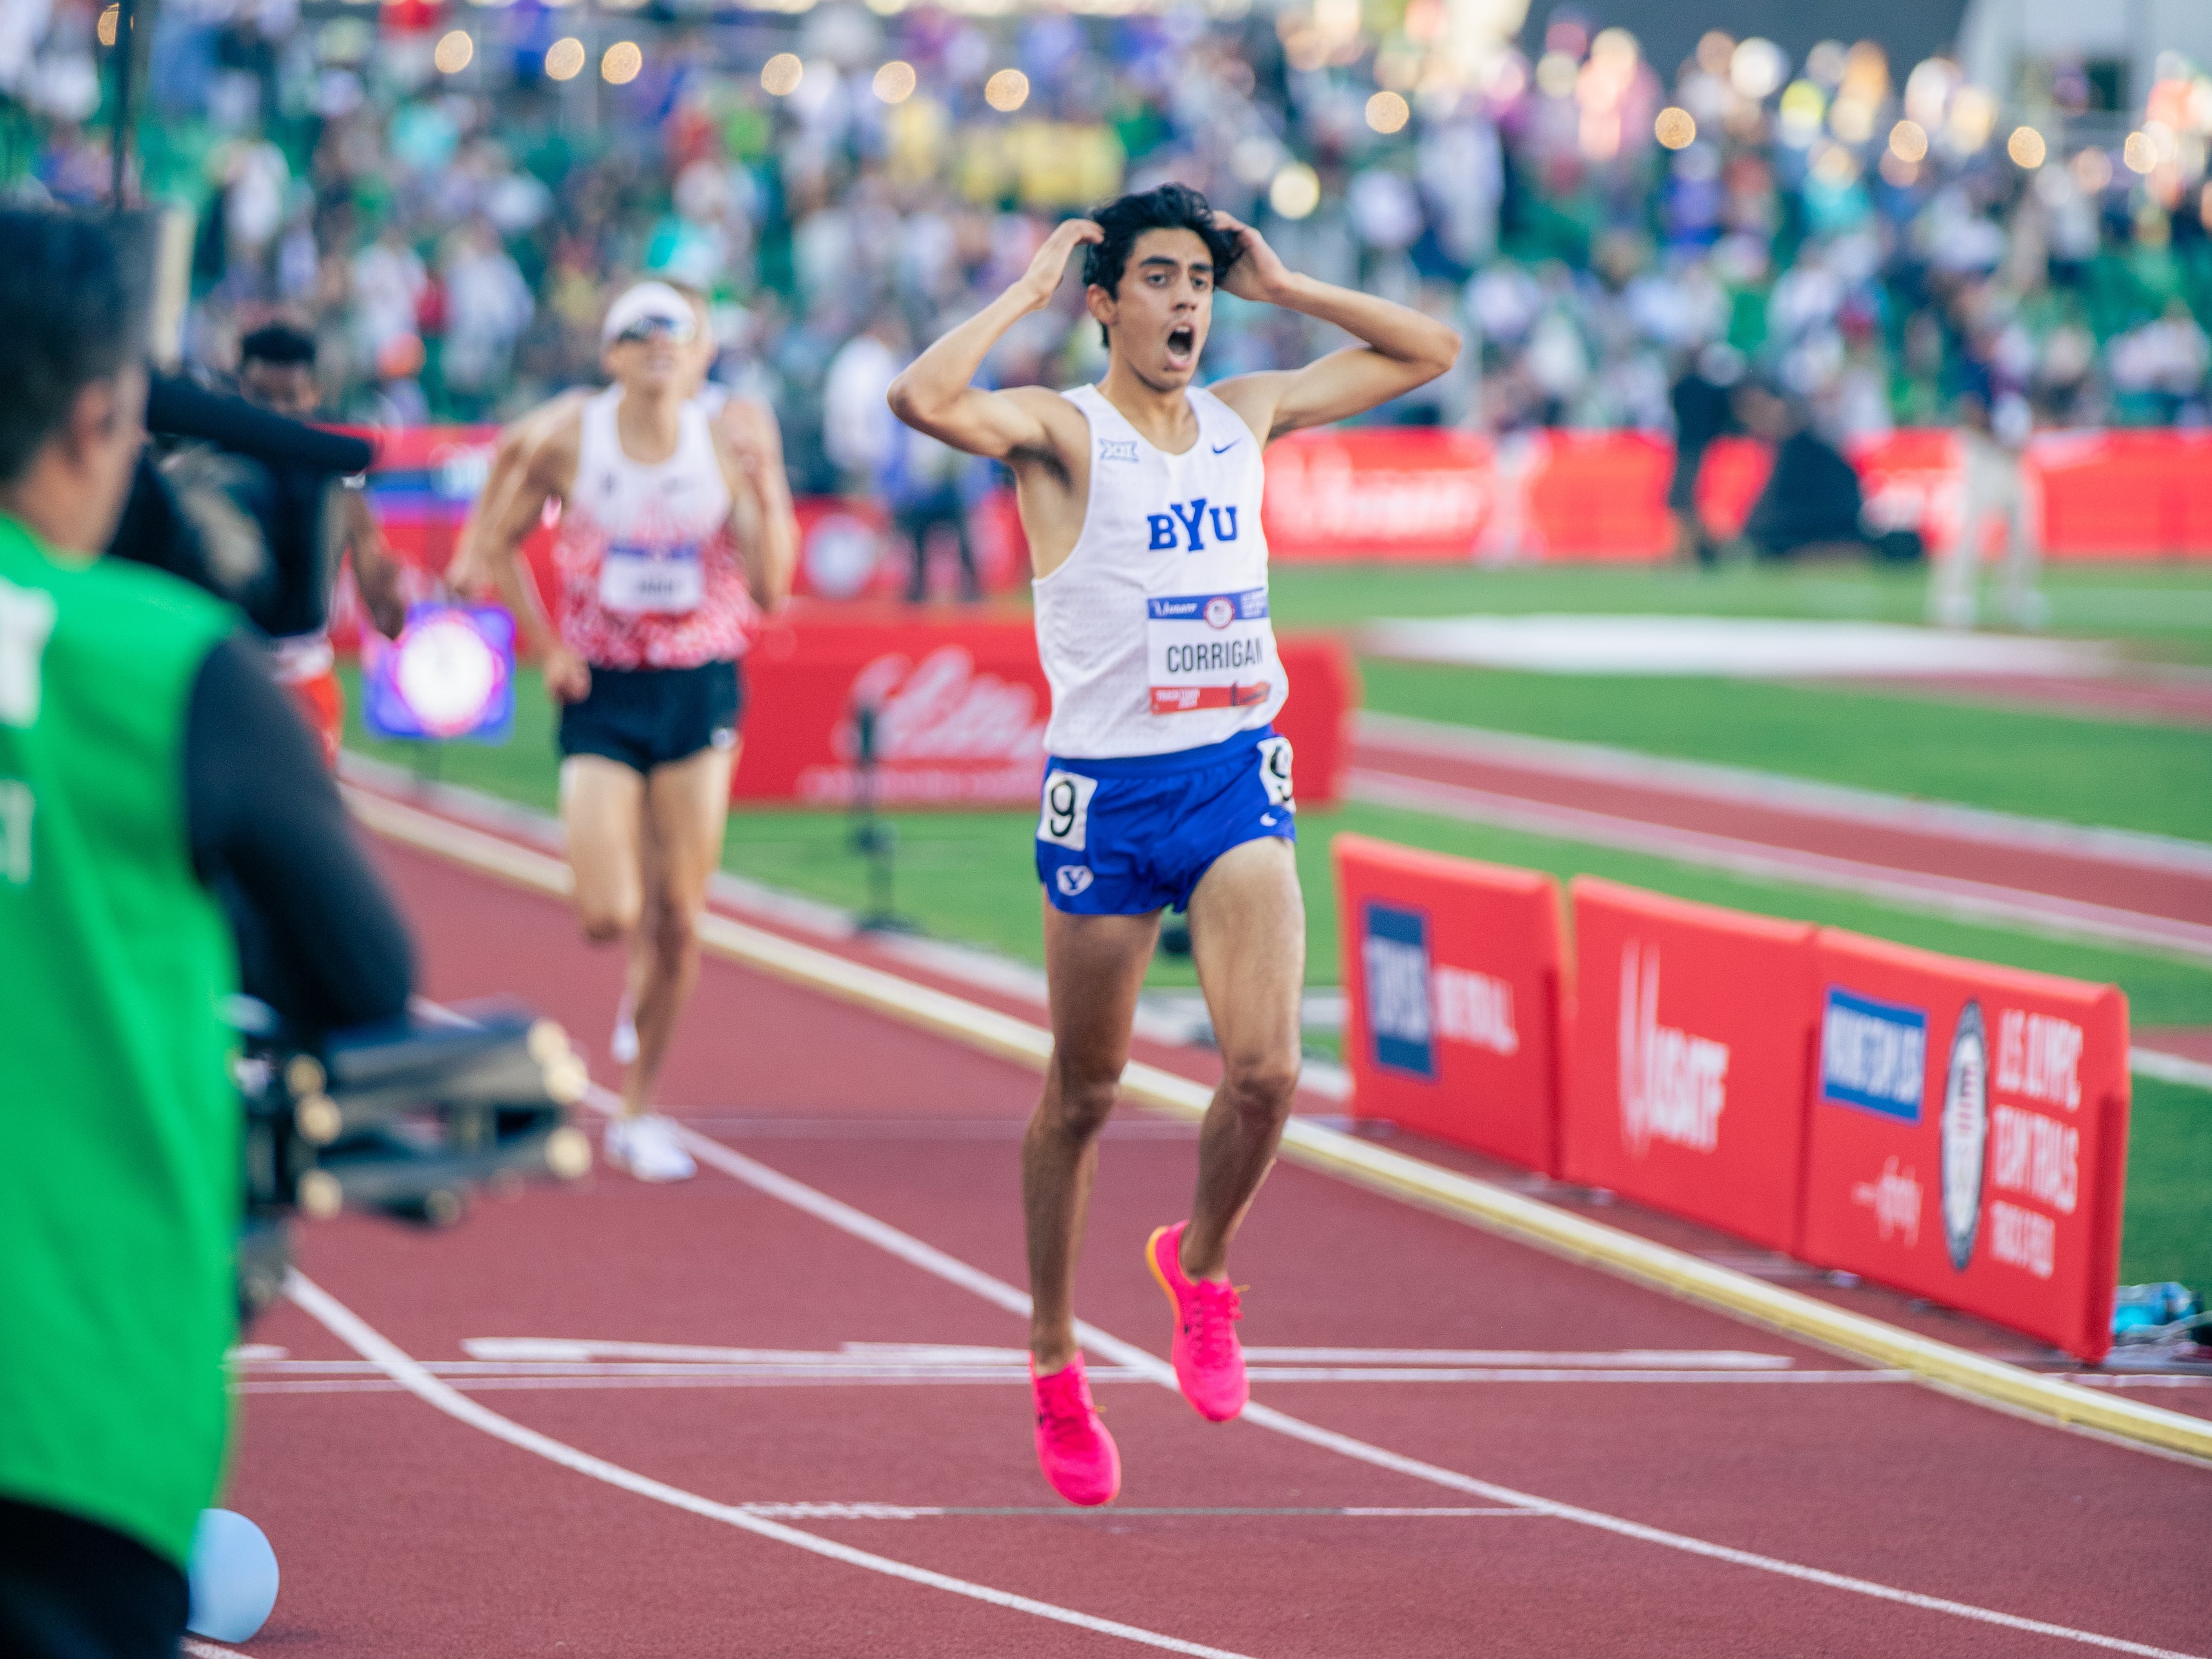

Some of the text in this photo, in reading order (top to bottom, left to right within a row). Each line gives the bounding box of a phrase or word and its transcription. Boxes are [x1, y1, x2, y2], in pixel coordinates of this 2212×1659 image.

[1147, 497, 1239, 553] BYU
[1167, 637, 1263, 673] CORRIGAN
[1050, 779, 1076, 837] 9
[1063, 870, 1084, 890] Y
